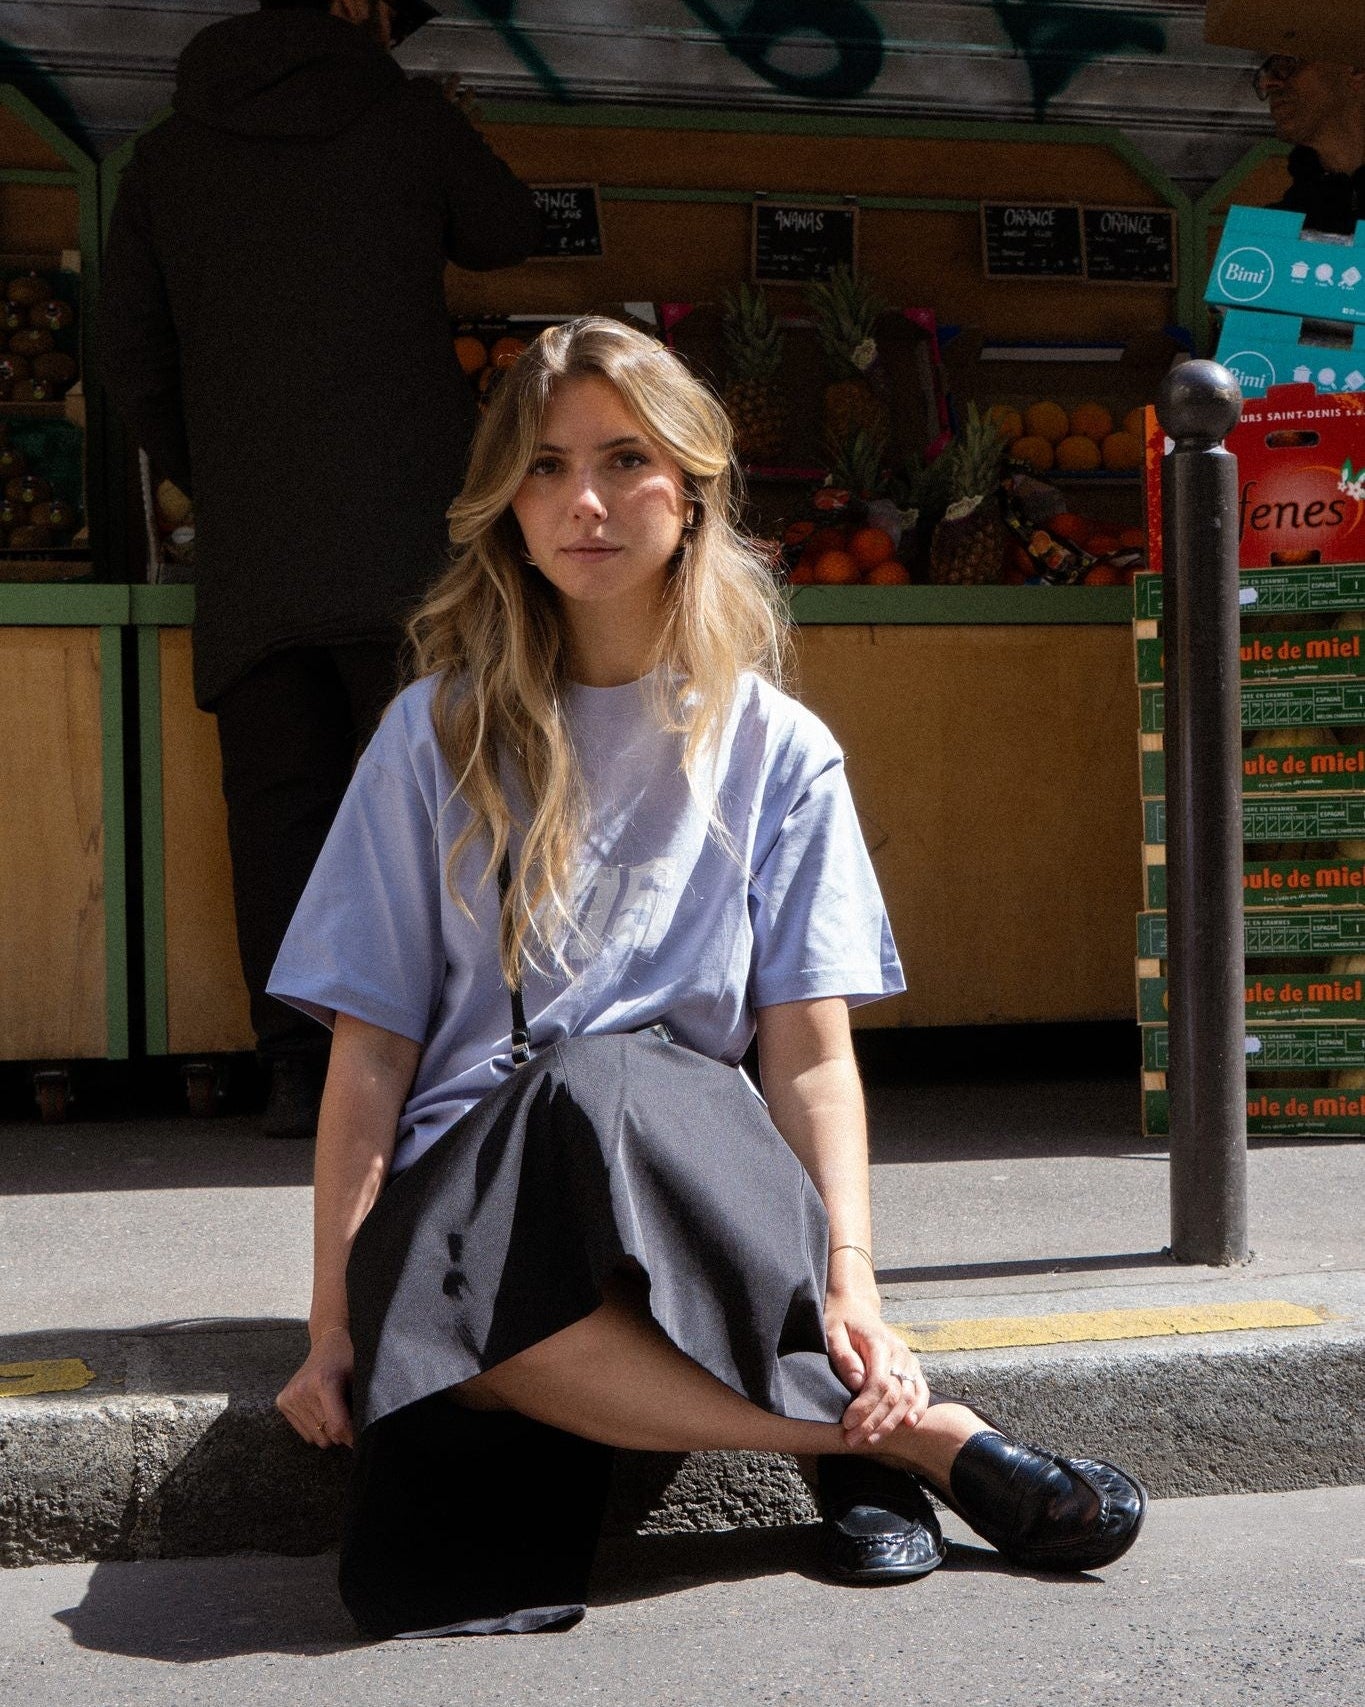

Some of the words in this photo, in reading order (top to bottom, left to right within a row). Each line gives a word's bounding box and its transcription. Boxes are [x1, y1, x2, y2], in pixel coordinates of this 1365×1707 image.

[533, 190, 577, 212] RANGE
[774, 210, 825, 233] ANANAS
[1003, 208, 1057, 226] ORANGE
[1100, 212, 1154, 234] ORANGE
[1225, 262, 1265, 284] Bimi
[1240, 413, 1262, 423] URS
[1267, 408, 1342, 421] SAINT-DENIS
[1240, 639, 1273, 661] ule
[1277, 640, 1301, 660] de
[1244, 753, 1278, 775] ule
[1282, 753, 1306, 774] de
[1242, 867, 1283, 889] ule
[1287, 868, 1310, 888] de
[1244, 981, 1275, 1003] ule
[1279, 982, 1303, 1002] de
[1247, 1095, 1280, 1116] ule
[1284, 1096, 1309, 1116] de
